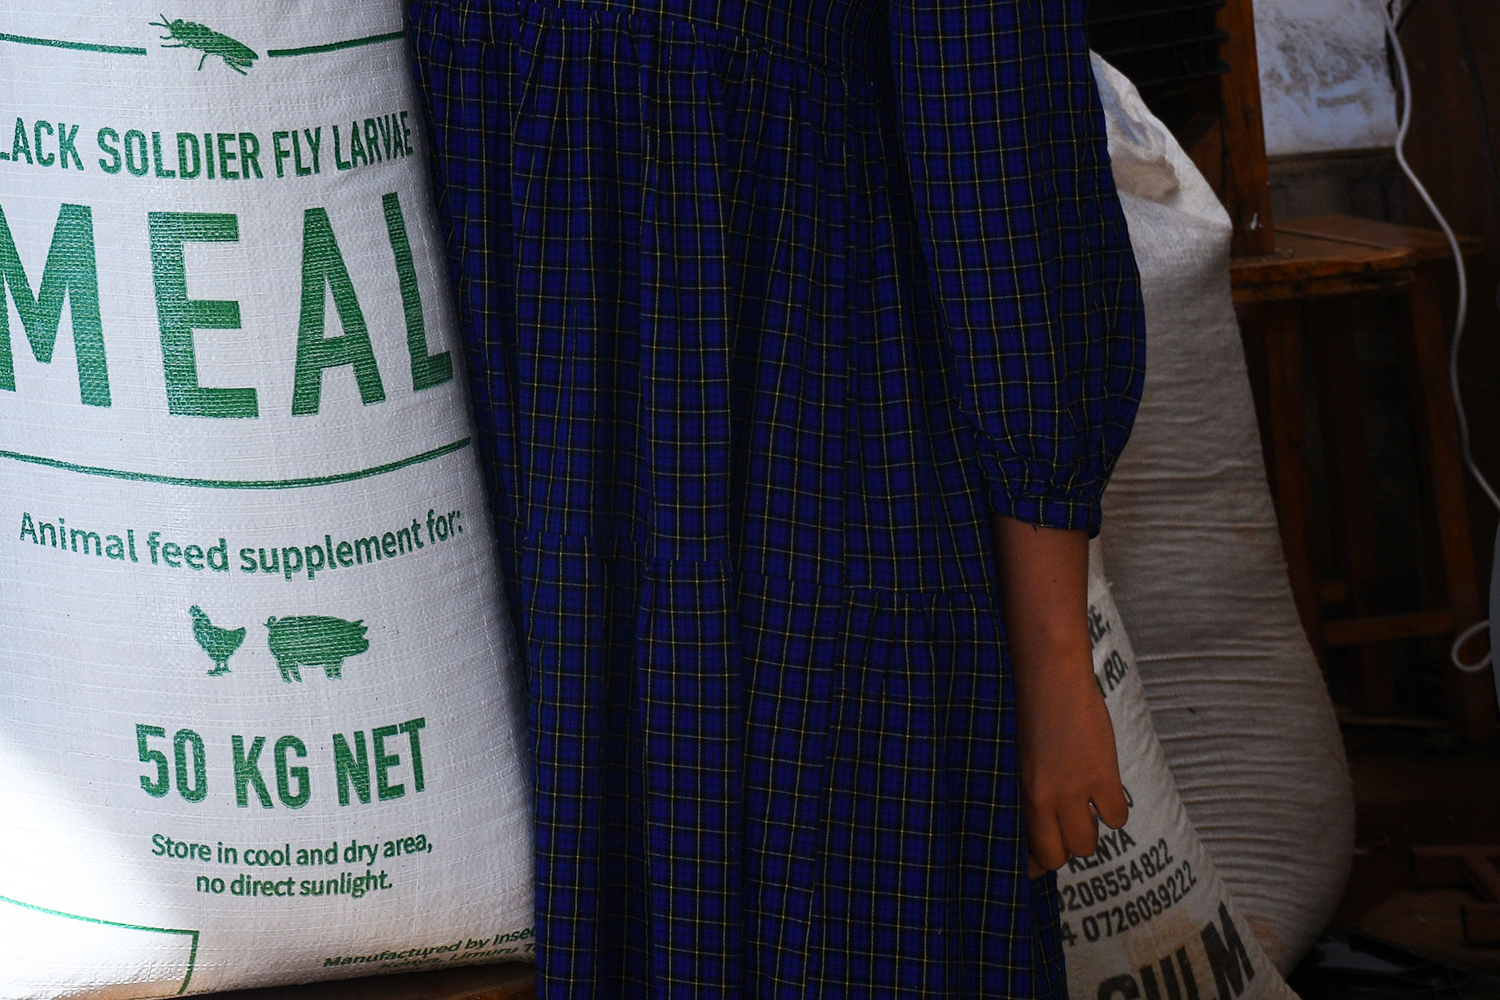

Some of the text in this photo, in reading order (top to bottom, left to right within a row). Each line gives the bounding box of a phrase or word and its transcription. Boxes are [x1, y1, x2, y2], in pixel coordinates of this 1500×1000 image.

[97, 126, 263, 180] SOLDIER
[273, 128, 321, 178] FLY
[334, 110, 414, 171] LARVAE
[20, 508, 463, 582] Animal feed supplement for:
[135, 718, 425, 809] 50 KG NET
[152, 834, 433, 866] Store in cool and dry area,
[197, 870, 393, 898] no direct sunlight.
[1082, 860, 1197, 943] 0726039222
[322, 938, 462, 967] Manufactured
[464, 937, 491, 951] by
